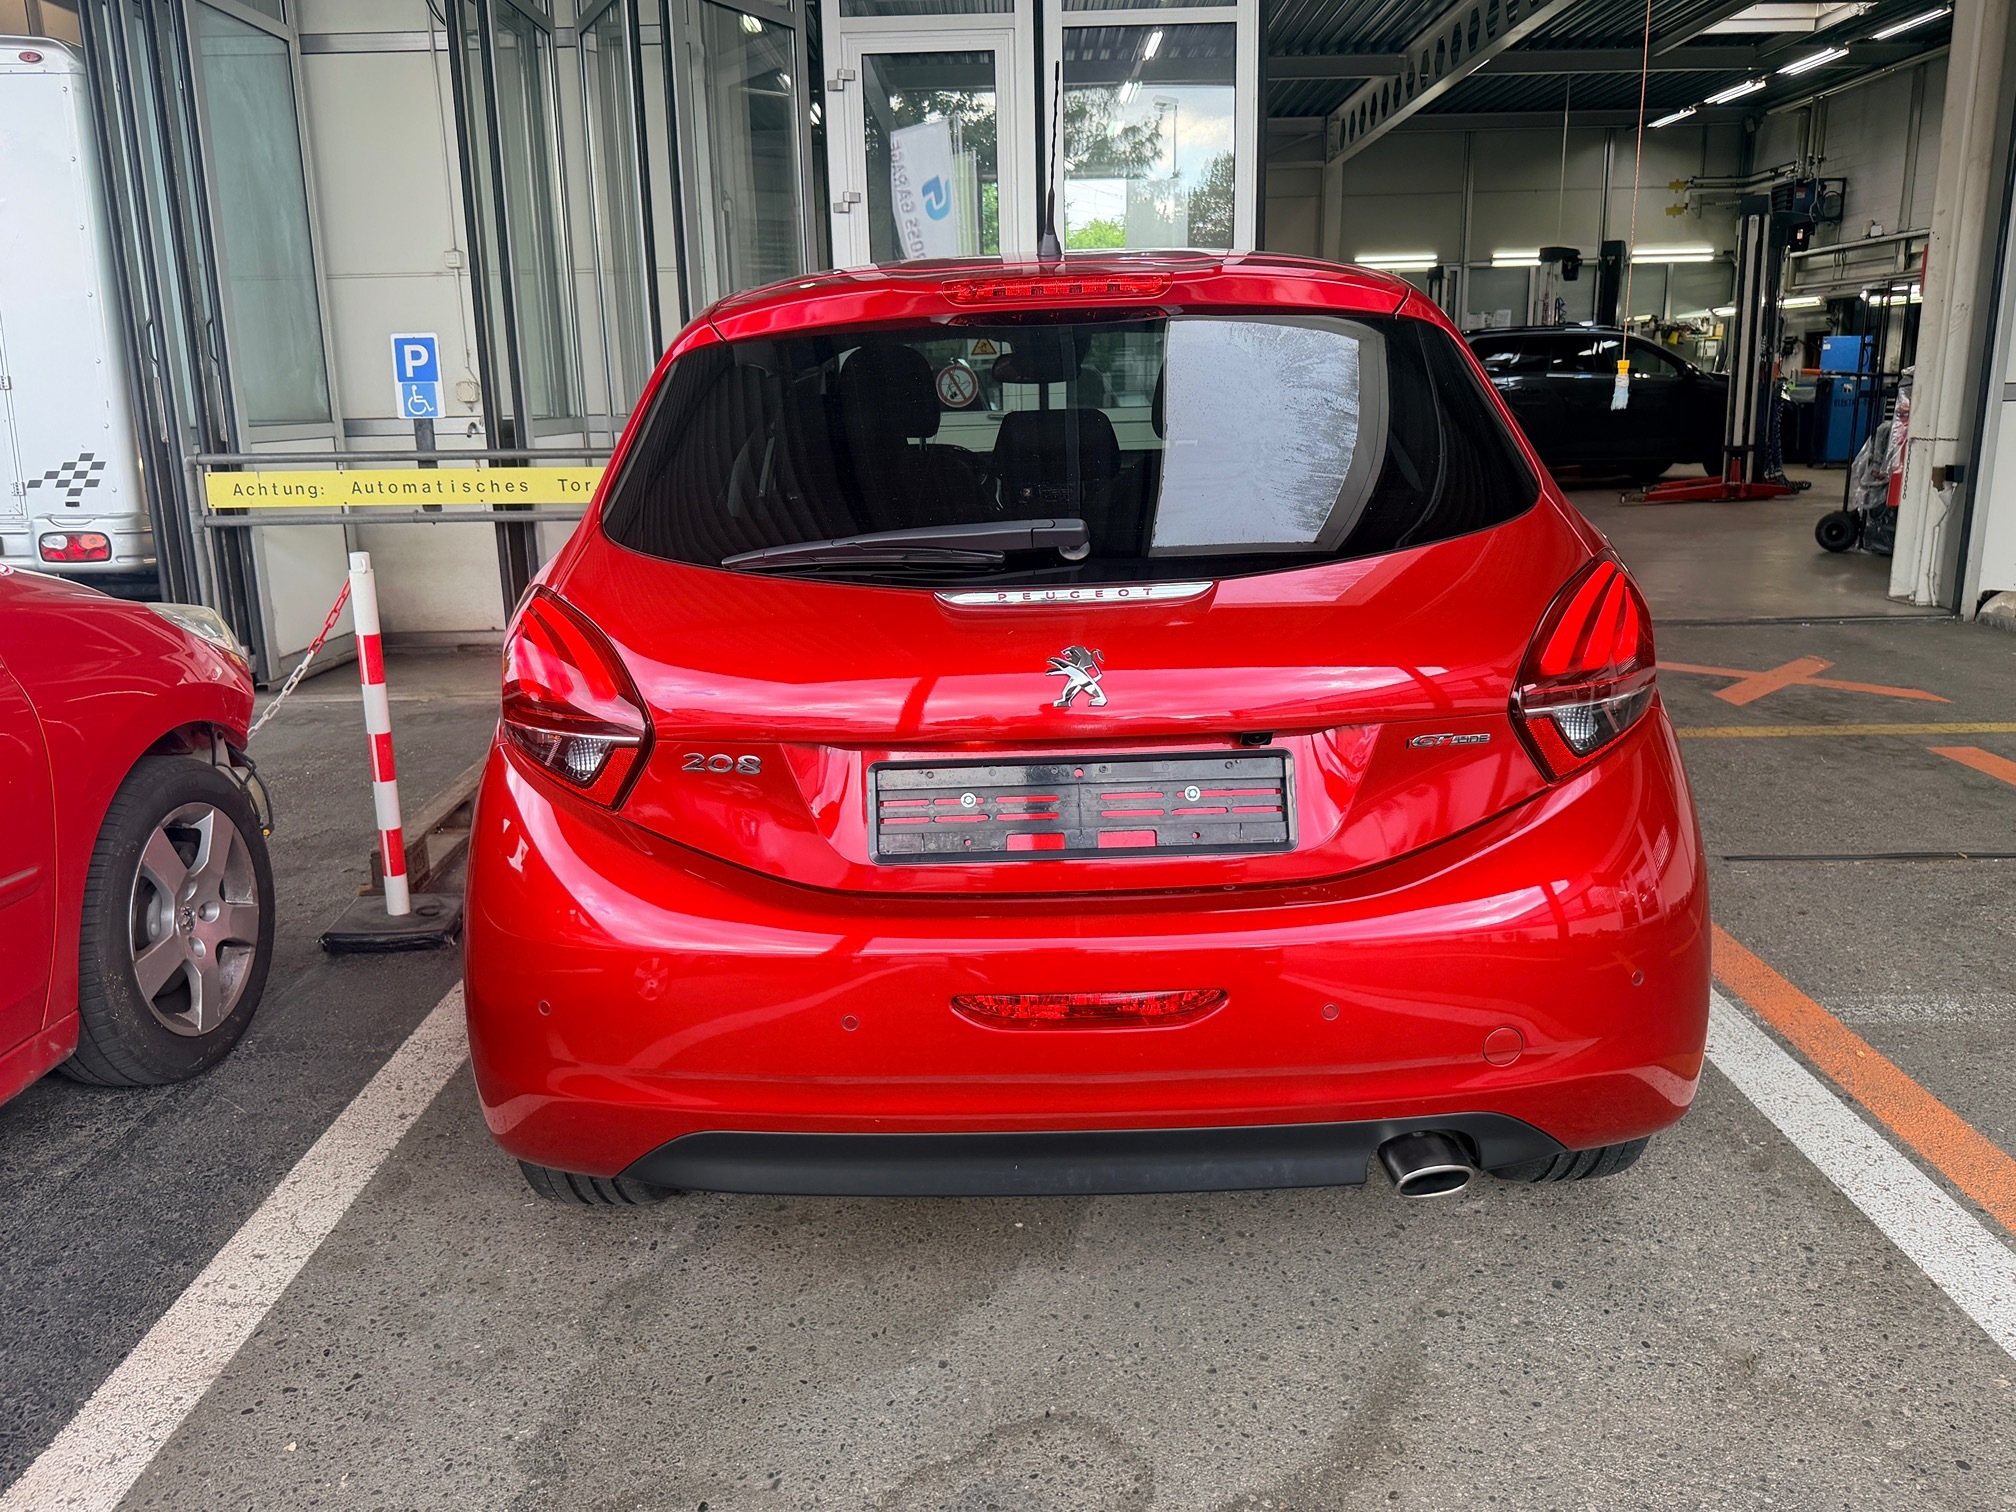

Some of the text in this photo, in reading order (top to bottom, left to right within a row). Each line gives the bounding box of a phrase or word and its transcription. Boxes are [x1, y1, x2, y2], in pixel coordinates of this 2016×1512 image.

[404, 344, 429, 377] P
[233, 482, 325, 499] Achtung:
[352, 479, 529, 494] Automatisches
[997, 588, 1152, 601] PEUGEOT
[1412, 733, 1454, 748] GT
[682, 752, 761, 775] 208
